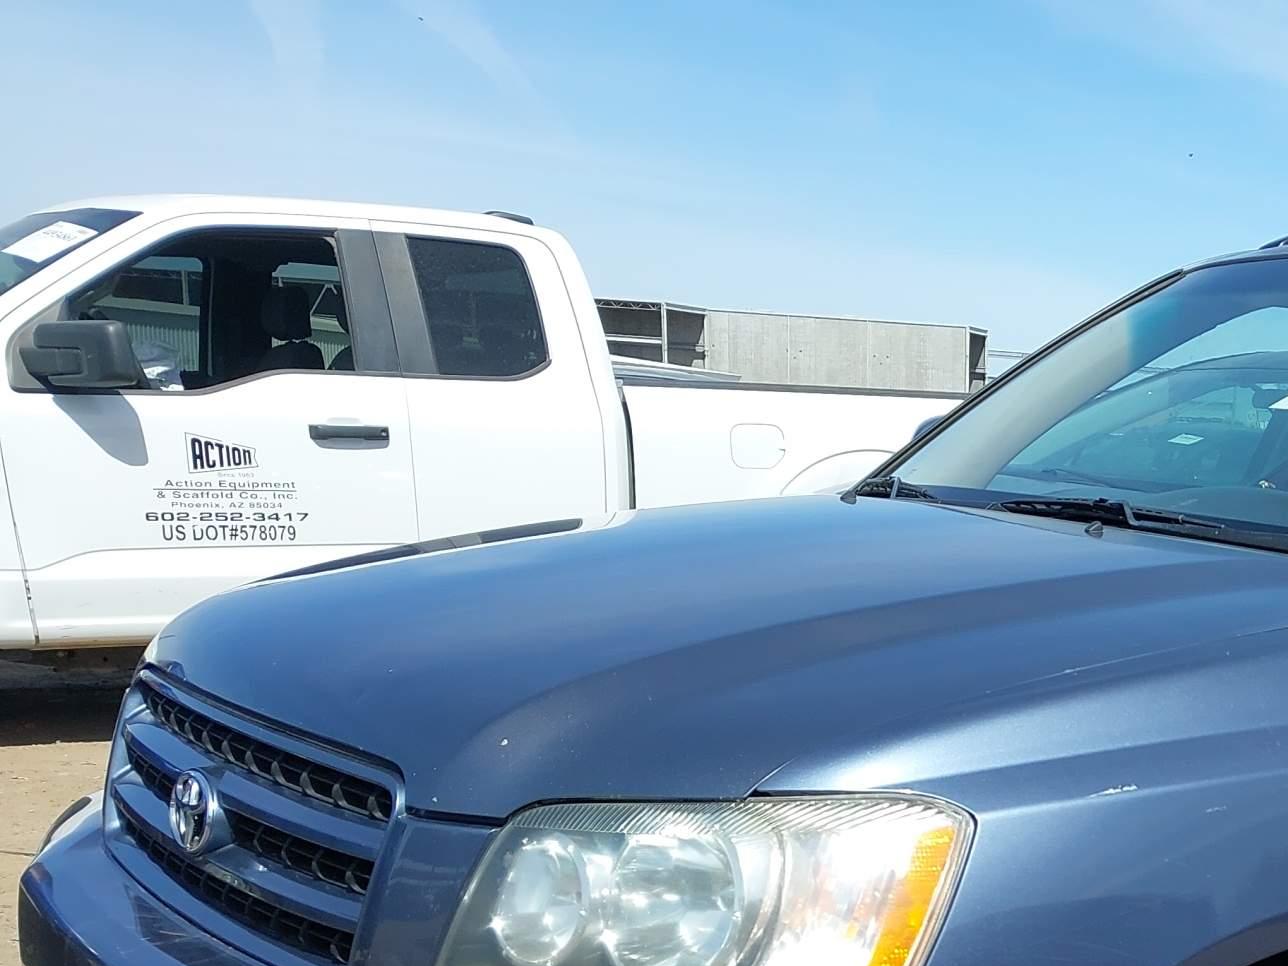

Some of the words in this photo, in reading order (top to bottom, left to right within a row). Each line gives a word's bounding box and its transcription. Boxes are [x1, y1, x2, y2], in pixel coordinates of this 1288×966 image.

[164, 479, 212, 488] Action
[218, 479, 296, 490] Equipment
[156, 490, 166, 499] &
[172, 490, 234, 499] Scaffold
[273, 492, 298, 500] Inc.
[171, 501, 224, 509] Phoenix,
[145, 512, 309, 522] 602-252-3417
[162, 524, 186, 541] US
[192, 524, 297, 541] DOT#578079
